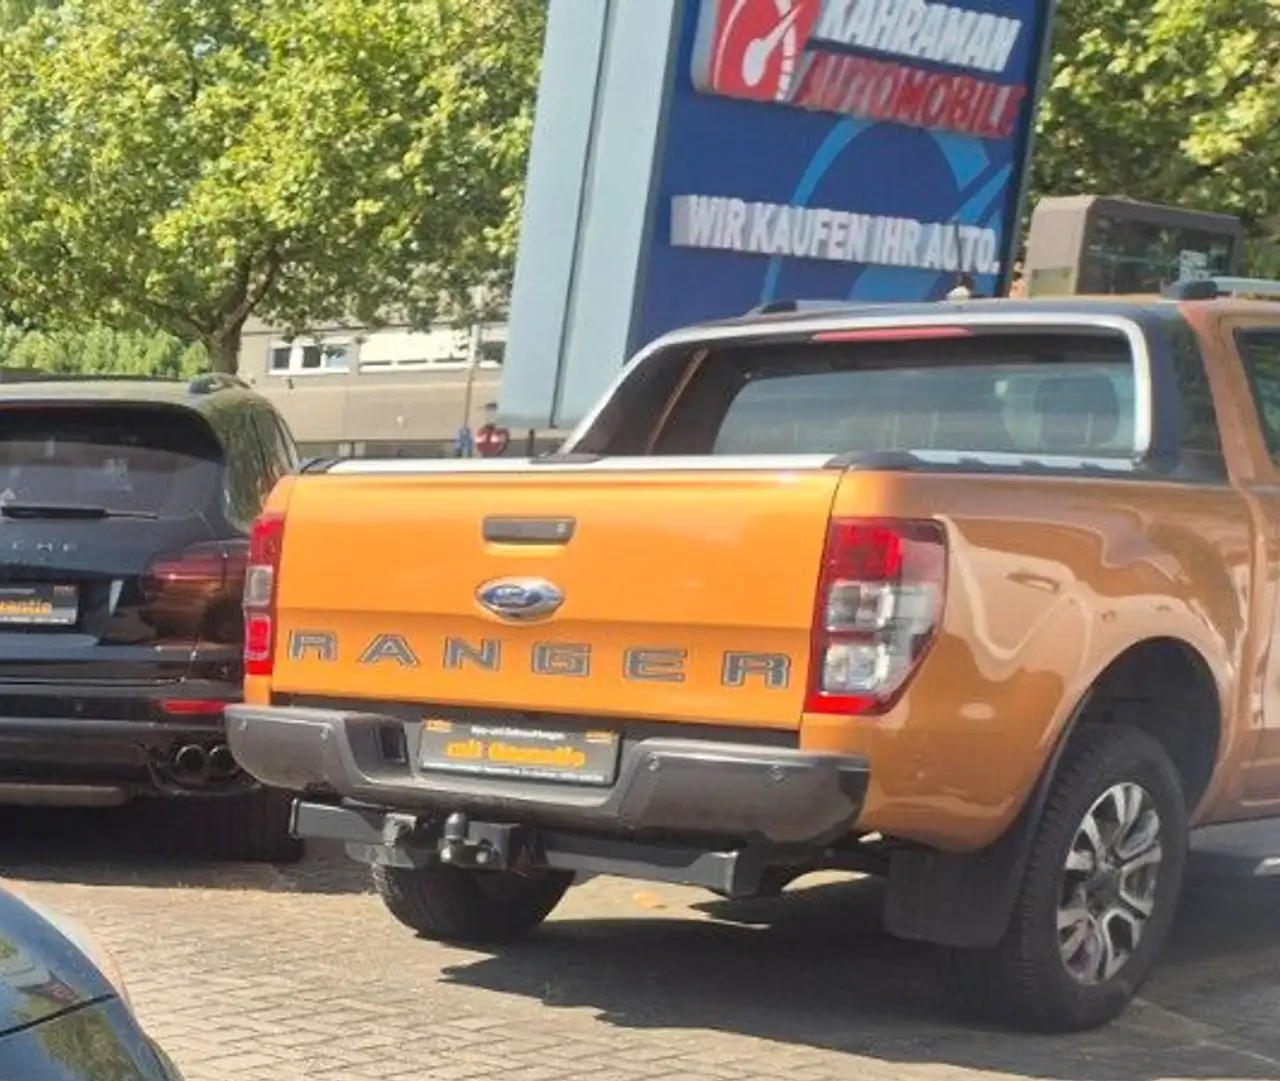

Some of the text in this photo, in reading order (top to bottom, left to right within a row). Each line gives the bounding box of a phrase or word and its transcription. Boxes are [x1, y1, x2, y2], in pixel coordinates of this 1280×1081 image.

[816, 0, 1023, 72] KAHRAMAN
[797, 51, 1028, 139] AUTOMOBILE
[688, 195, 746, 250] WIR
[747, 203, 870, 263] KAUFEN
[873, 214, 920, 268] IHR
[287, 629, 792, 689] RANGER
